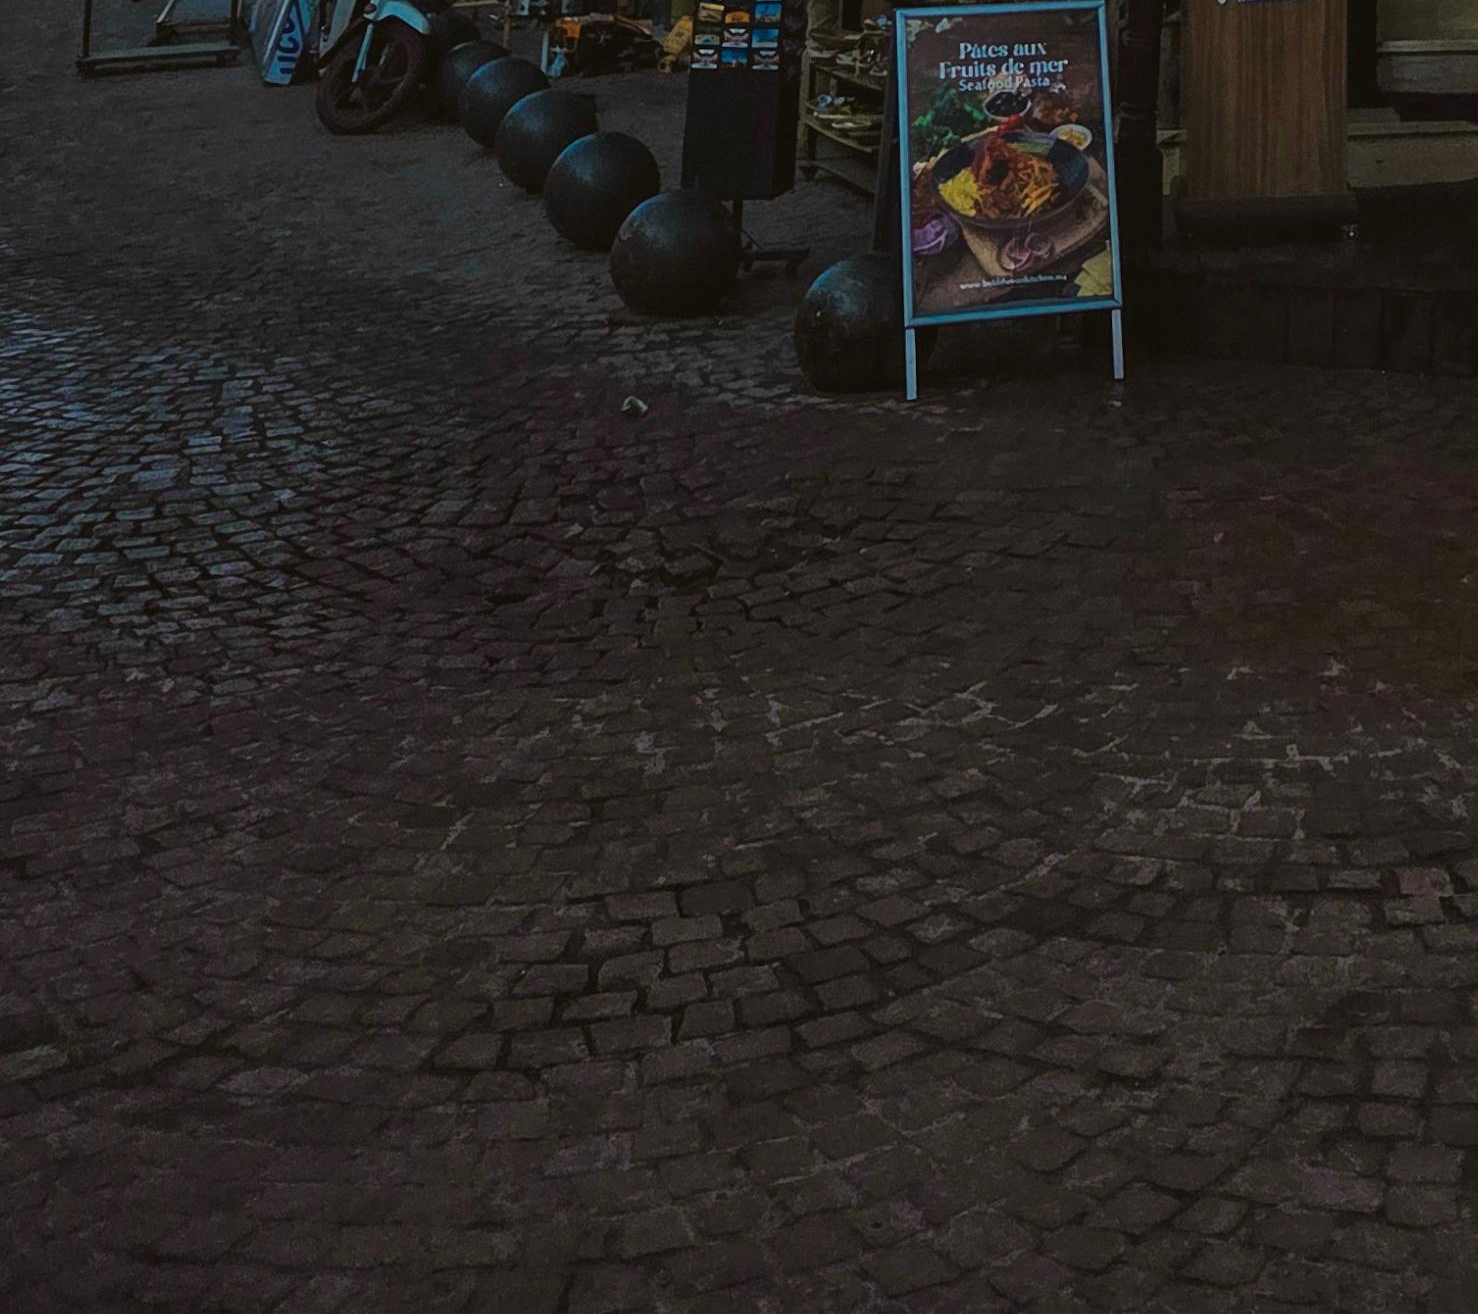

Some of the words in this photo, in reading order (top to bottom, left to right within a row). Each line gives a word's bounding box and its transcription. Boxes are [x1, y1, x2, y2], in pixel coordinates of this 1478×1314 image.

[1013, 42, 1048, 56] aux
[939, 59, 996, 79] Fruits
[1001, 57, 1024, 75] de
[1029, 59, 1069, 77] mer
[959, 75, 1013, 91] Seafood
[1014, 75, 1051, 90] Pasta
